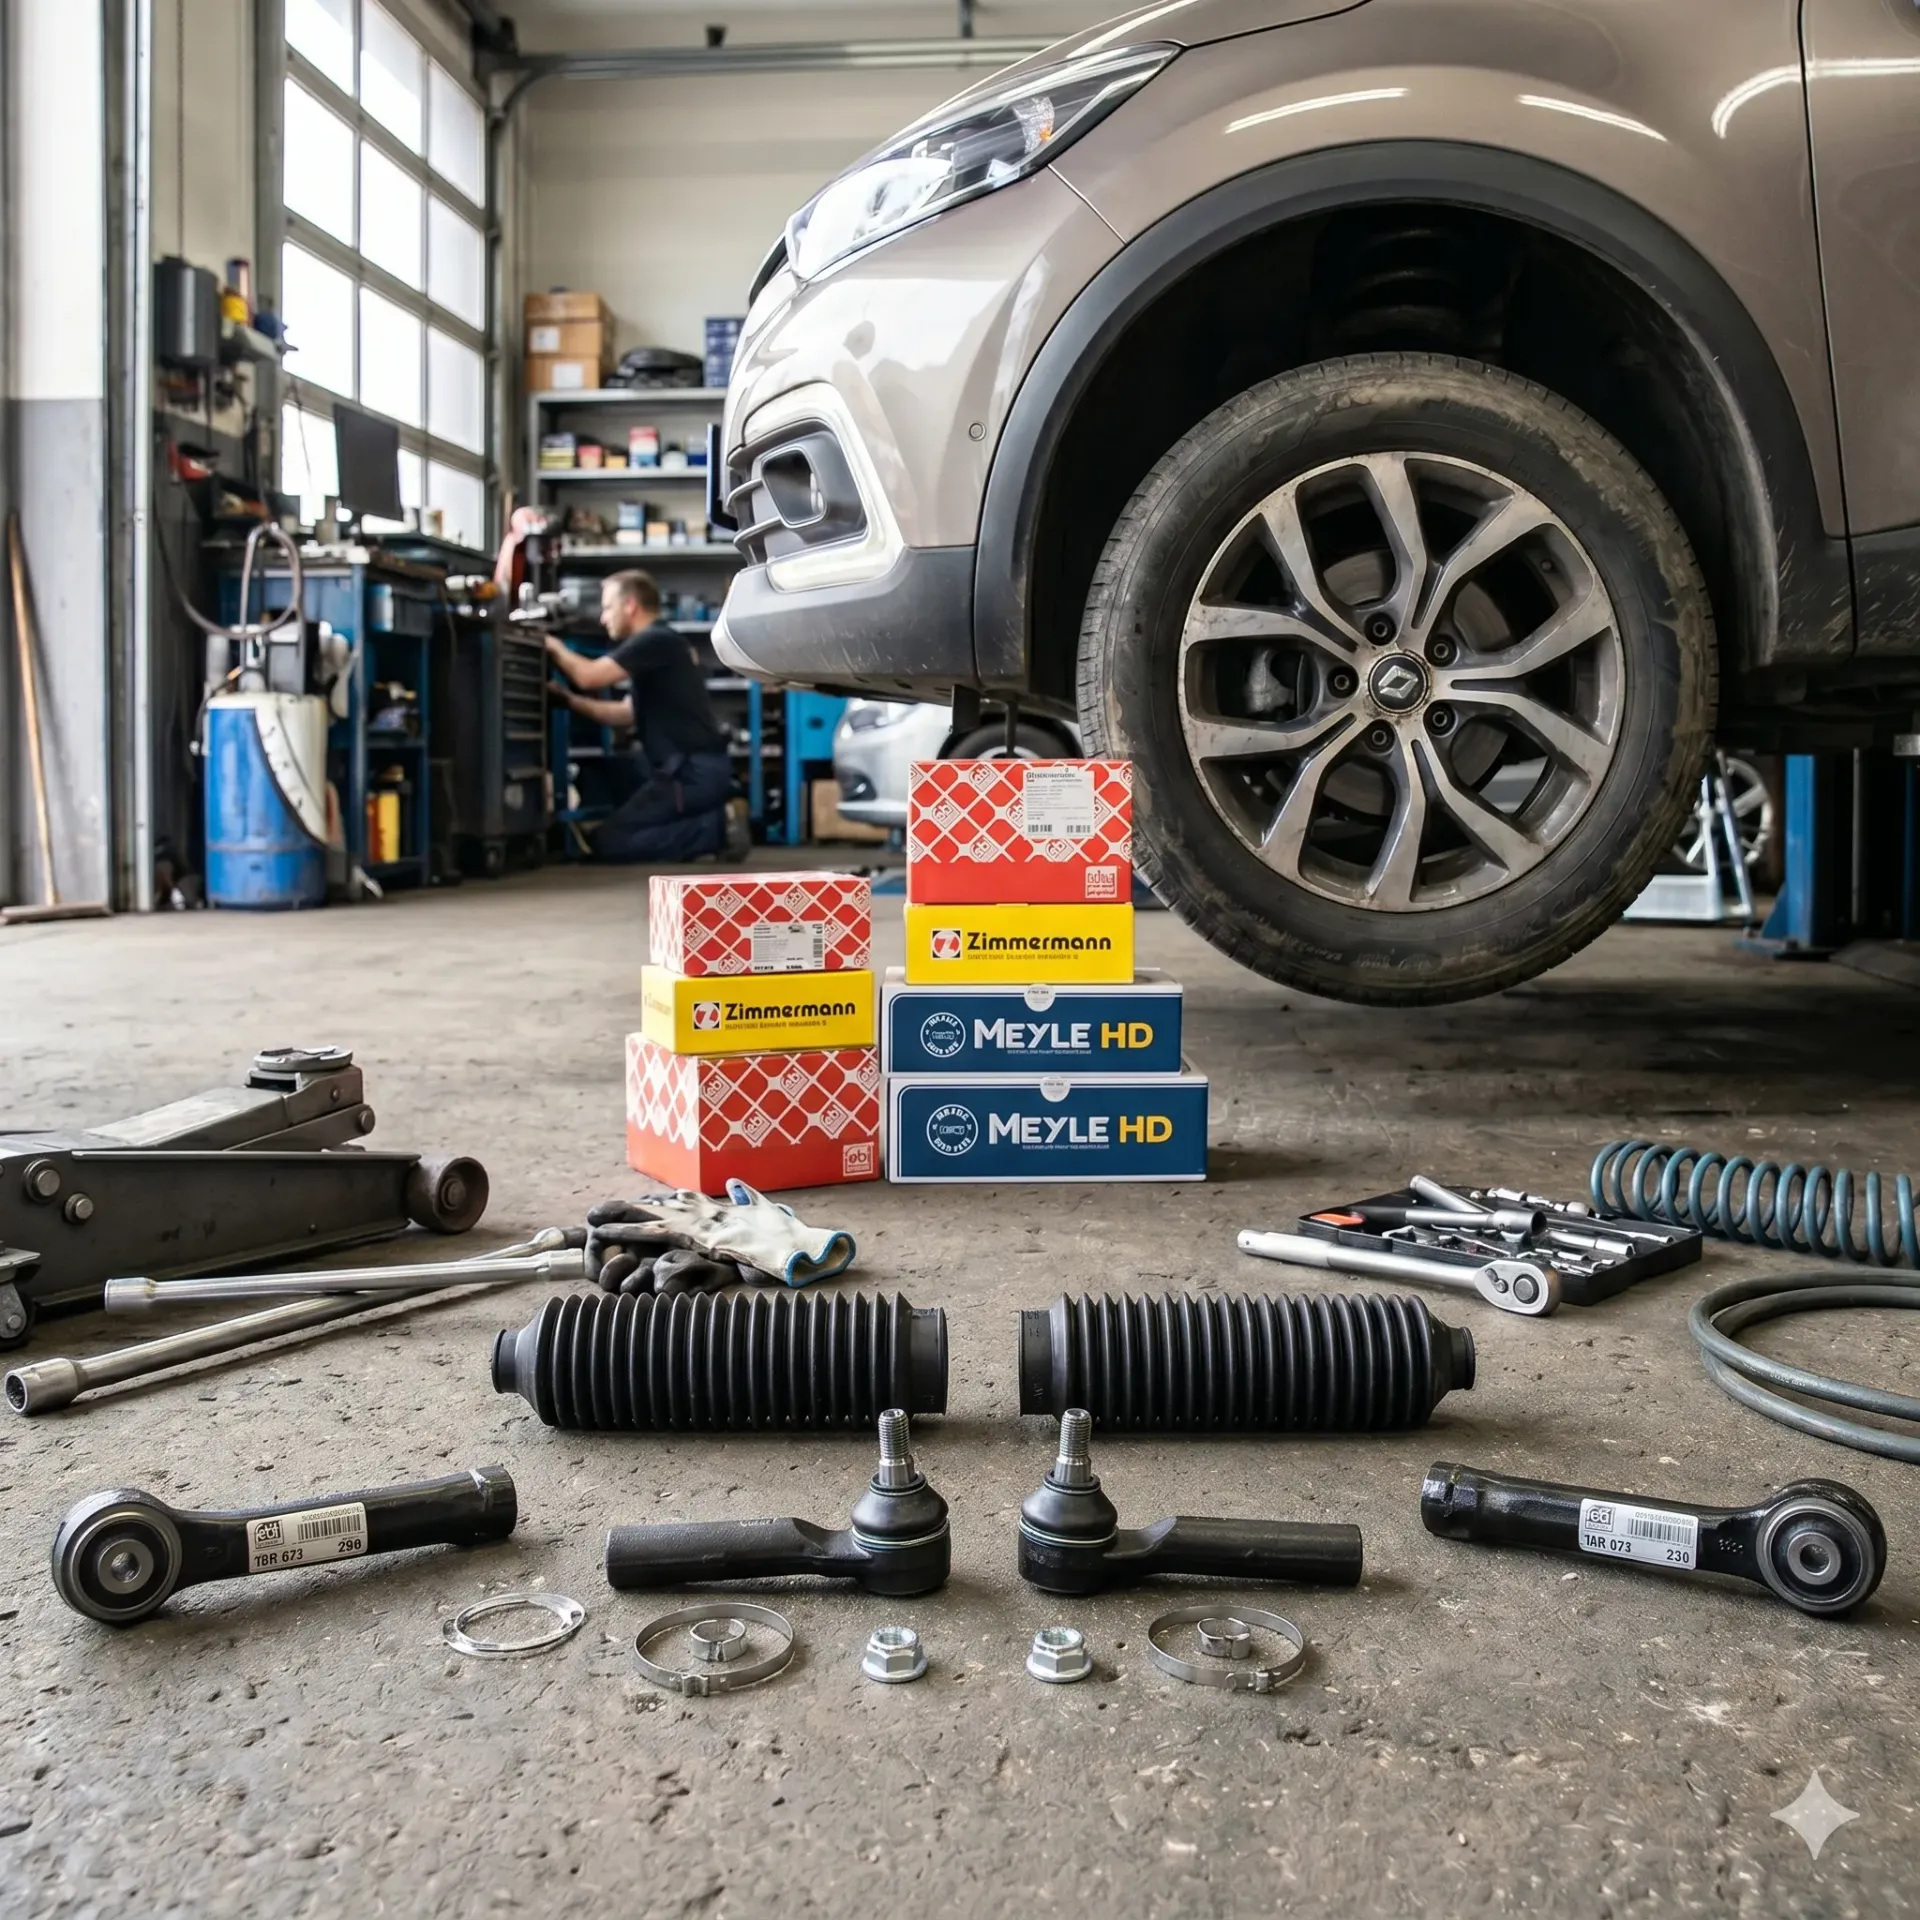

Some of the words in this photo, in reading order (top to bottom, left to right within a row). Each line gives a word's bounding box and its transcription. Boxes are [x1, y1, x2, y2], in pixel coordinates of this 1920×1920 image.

[967, 932, 1111, 950] Zimmermann
[725, 1002, 855, 1020] Zimmermann
[974, 1018, 1091, 1048] MEYLE
[1101, 1022, 1153, 1048] HD
[989, 1113, 1109, 1144] MEYLE
[1119, 1116, 1173, 1143] HD
[282, 1548, 303, 1562] 673
[1610, 1539, 1632, 1553] 073
[1666, 1549, 1690, 1563] 230
